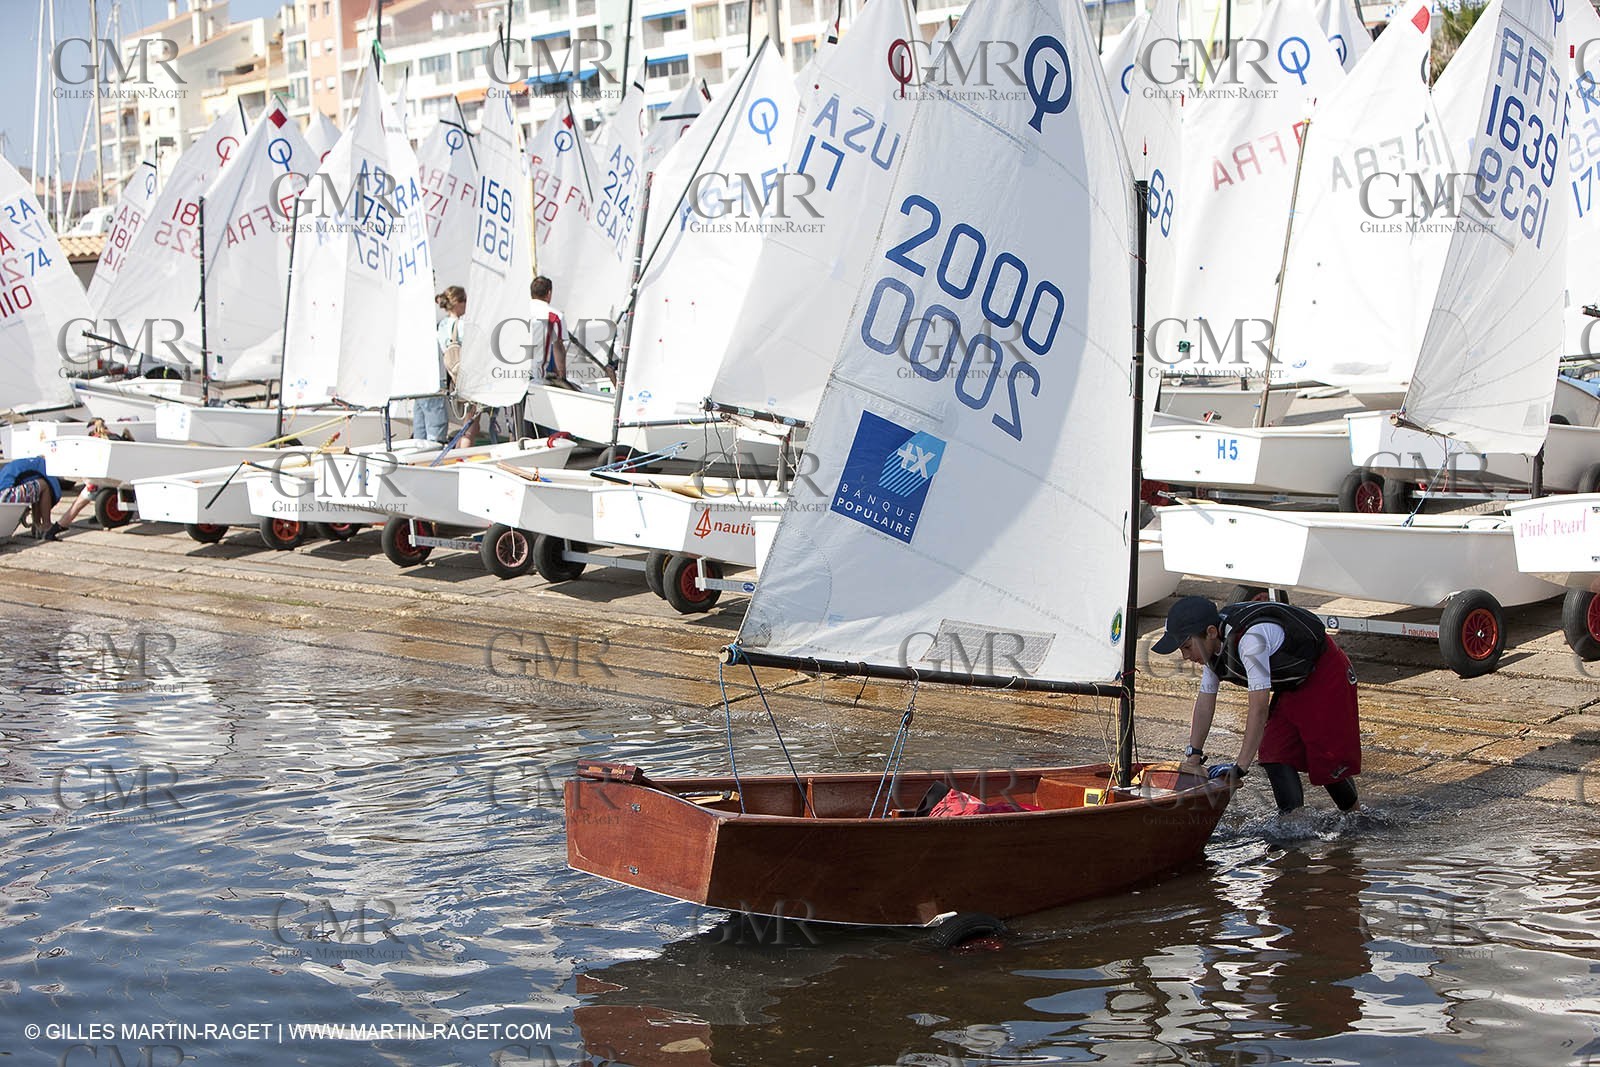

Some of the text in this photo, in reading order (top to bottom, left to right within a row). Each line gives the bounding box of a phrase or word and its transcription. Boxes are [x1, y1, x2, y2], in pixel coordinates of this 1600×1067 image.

[1486, 84, 1558, 188] 1639
[24, 247, 52, 277] 74
[885, 194, 1065, 356] 2000
[836, 497, 911, 537] POPULAIRE
[841, 483, 915, 522] BANQUE
[1520, 507, 1587, 538] Pink Pearl
